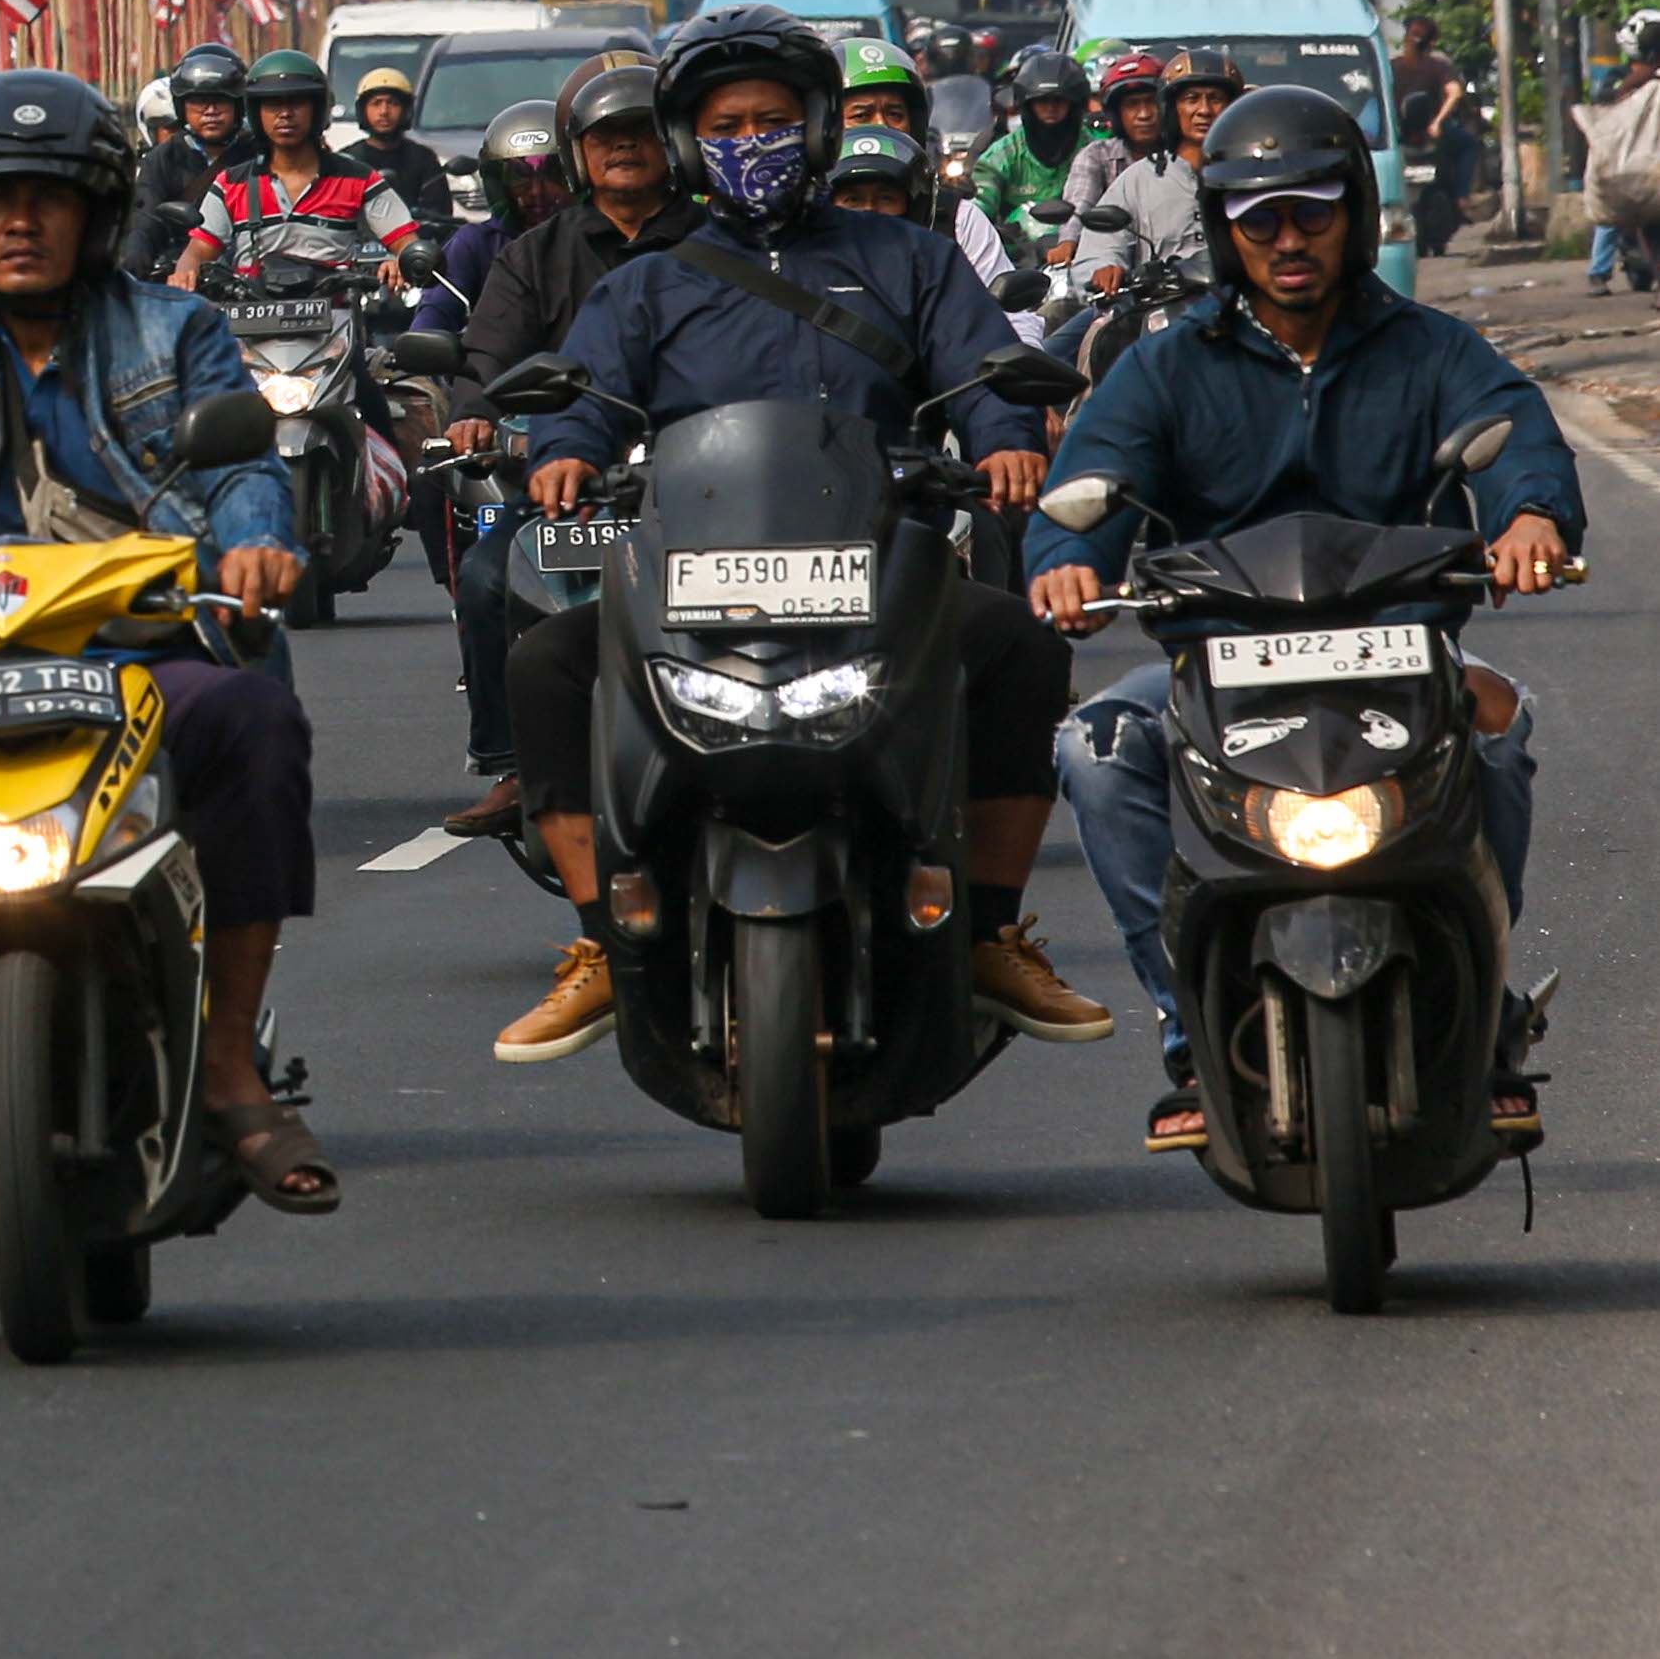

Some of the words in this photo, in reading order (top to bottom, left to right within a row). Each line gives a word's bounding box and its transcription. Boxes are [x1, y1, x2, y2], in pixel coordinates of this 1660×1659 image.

[295, 302, 324, 316] PHY
[484, 509, 496, 524] B
[543, 526, 557, 546] B
[678, 559, 693, 586] F
[715, 556, 788, 584] 5590
[810, 554, 868, 582] AAM
[681, 609, 723, 622] YAMAHA
[1220, 642, 1236, 660] B
[1254, 635, 1334, 660] 3022
[1357, 629, 1415, 653] SII
